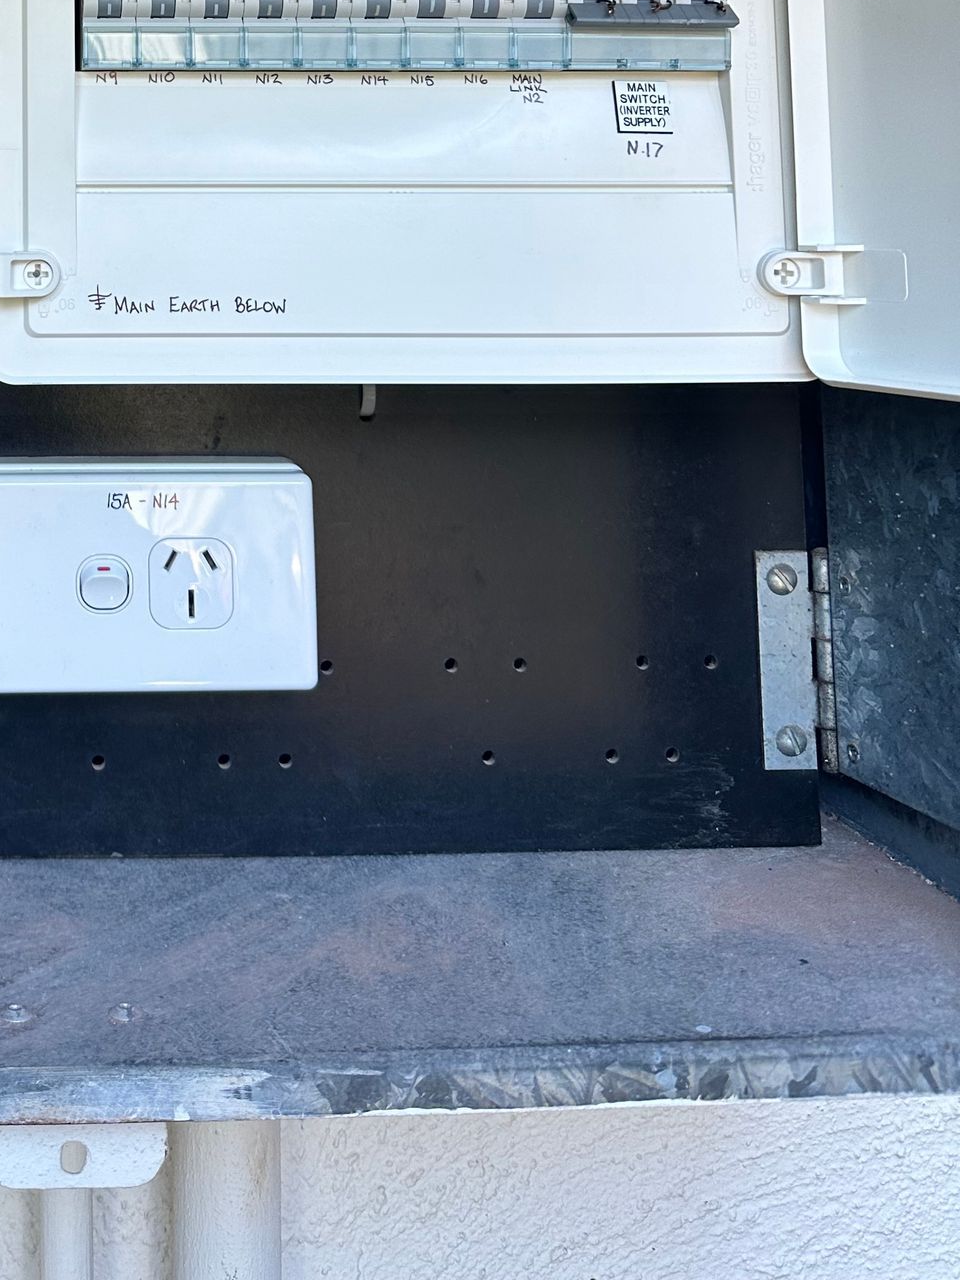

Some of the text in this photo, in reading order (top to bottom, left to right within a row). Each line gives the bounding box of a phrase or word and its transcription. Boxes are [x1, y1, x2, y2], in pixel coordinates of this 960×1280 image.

[96, 73, 117, 85] N9
[149, 72, 175, 83] N10
[202, 73, 222, 84] N11
[255, 74, 283, 84] N12
[307, 74, 334, 85] N13
[361, 75, 389, 85] N14
[411, 75, 434, 86] N15
[464, 74, 488, 85] N16
[512, 74, 542, 84] MAIN
[510, 85, 548, 93] LINK
[627, 83, 656, 92] MAIN
[523, 93, 544, 104] N2
[620, 94, 666, 104] SWITCH
[619, 106, 670, 116] (INVERTER
[623, 117, 666, 128] SUPPLY)
[114, 297, 286, 315] MAIN EARTH BELOW
[107, 493, 180, 510] 15A N14
